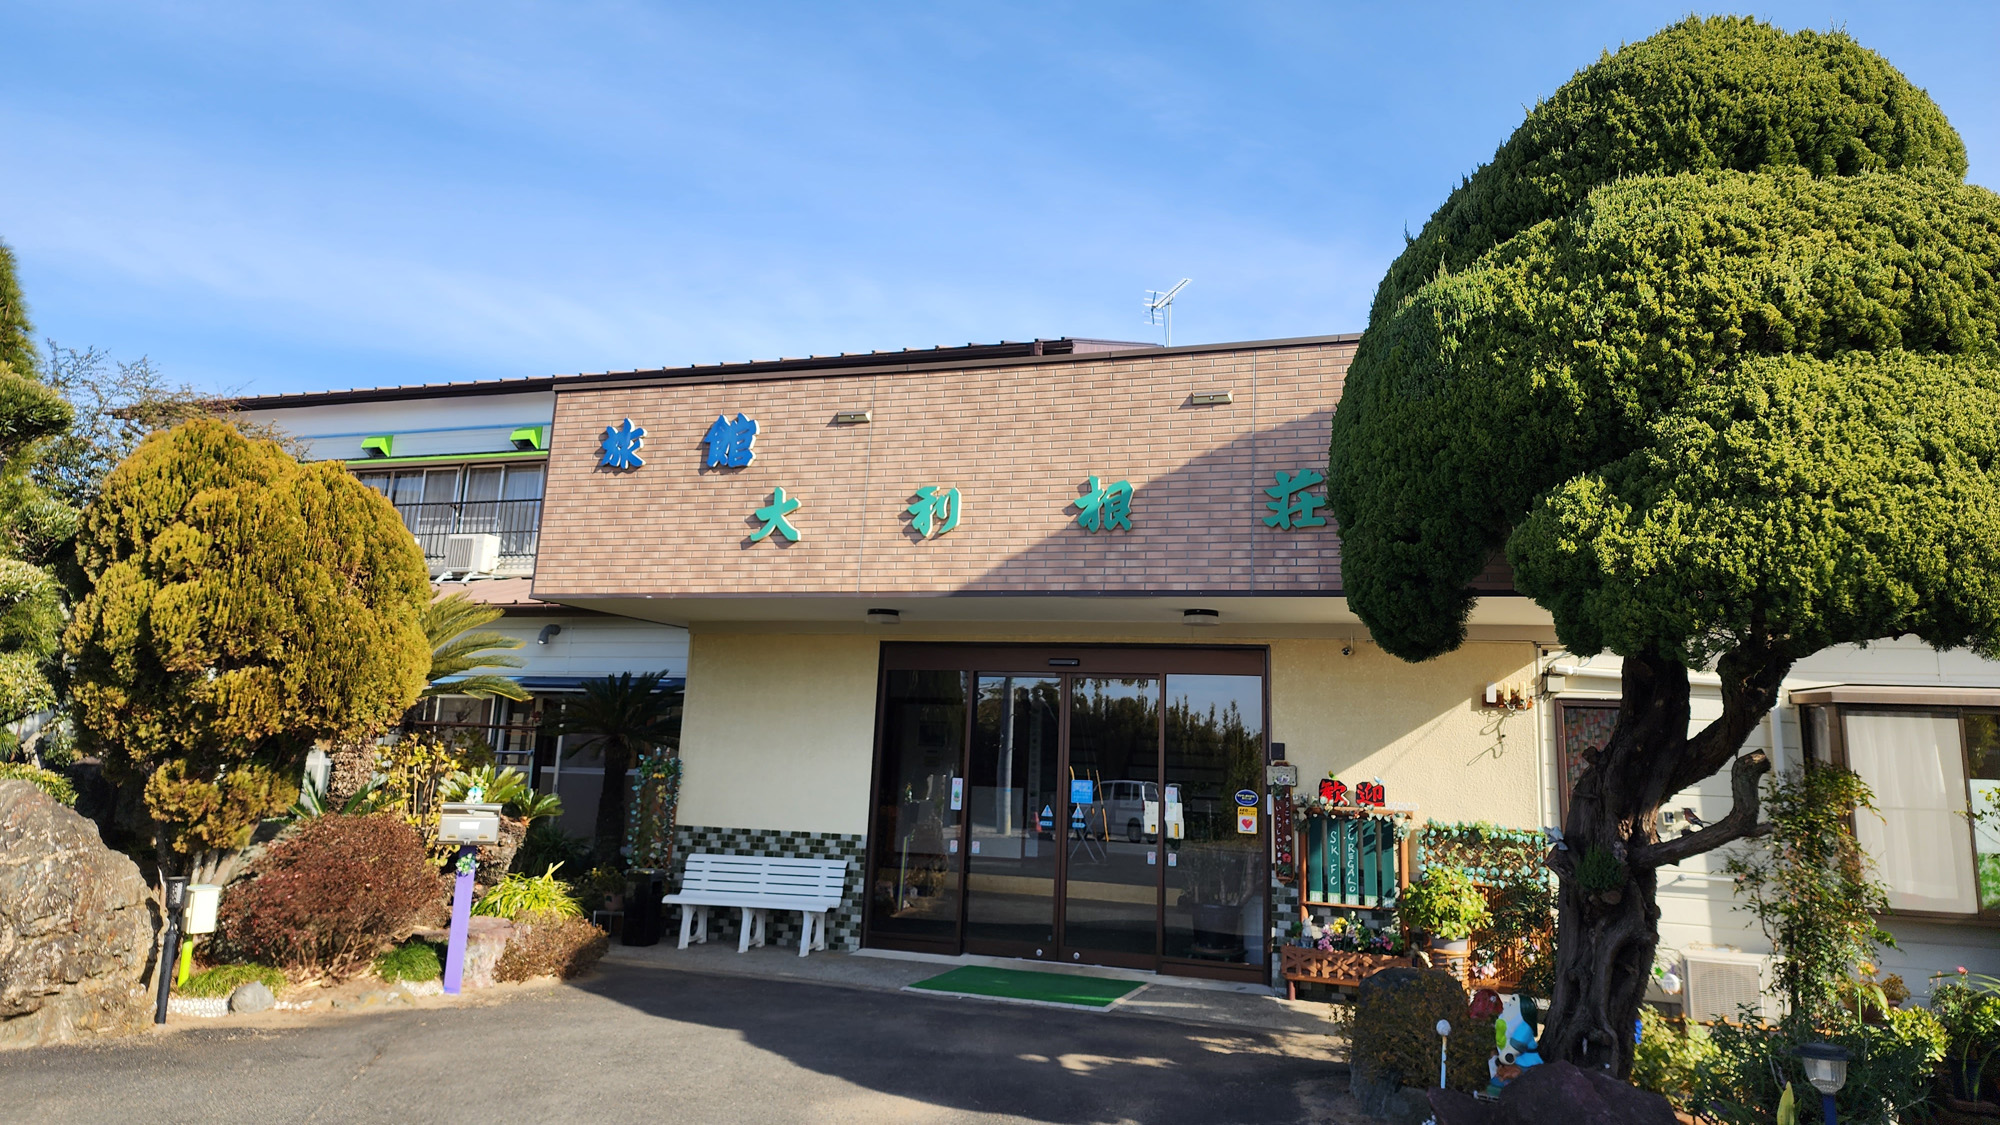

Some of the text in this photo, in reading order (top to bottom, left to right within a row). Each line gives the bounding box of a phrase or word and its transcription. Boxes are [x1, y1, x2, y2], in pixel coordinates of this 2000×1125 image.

[601, 412, 760, 469] 旅館
[750, 468, 1327, 542] 大利根荘
